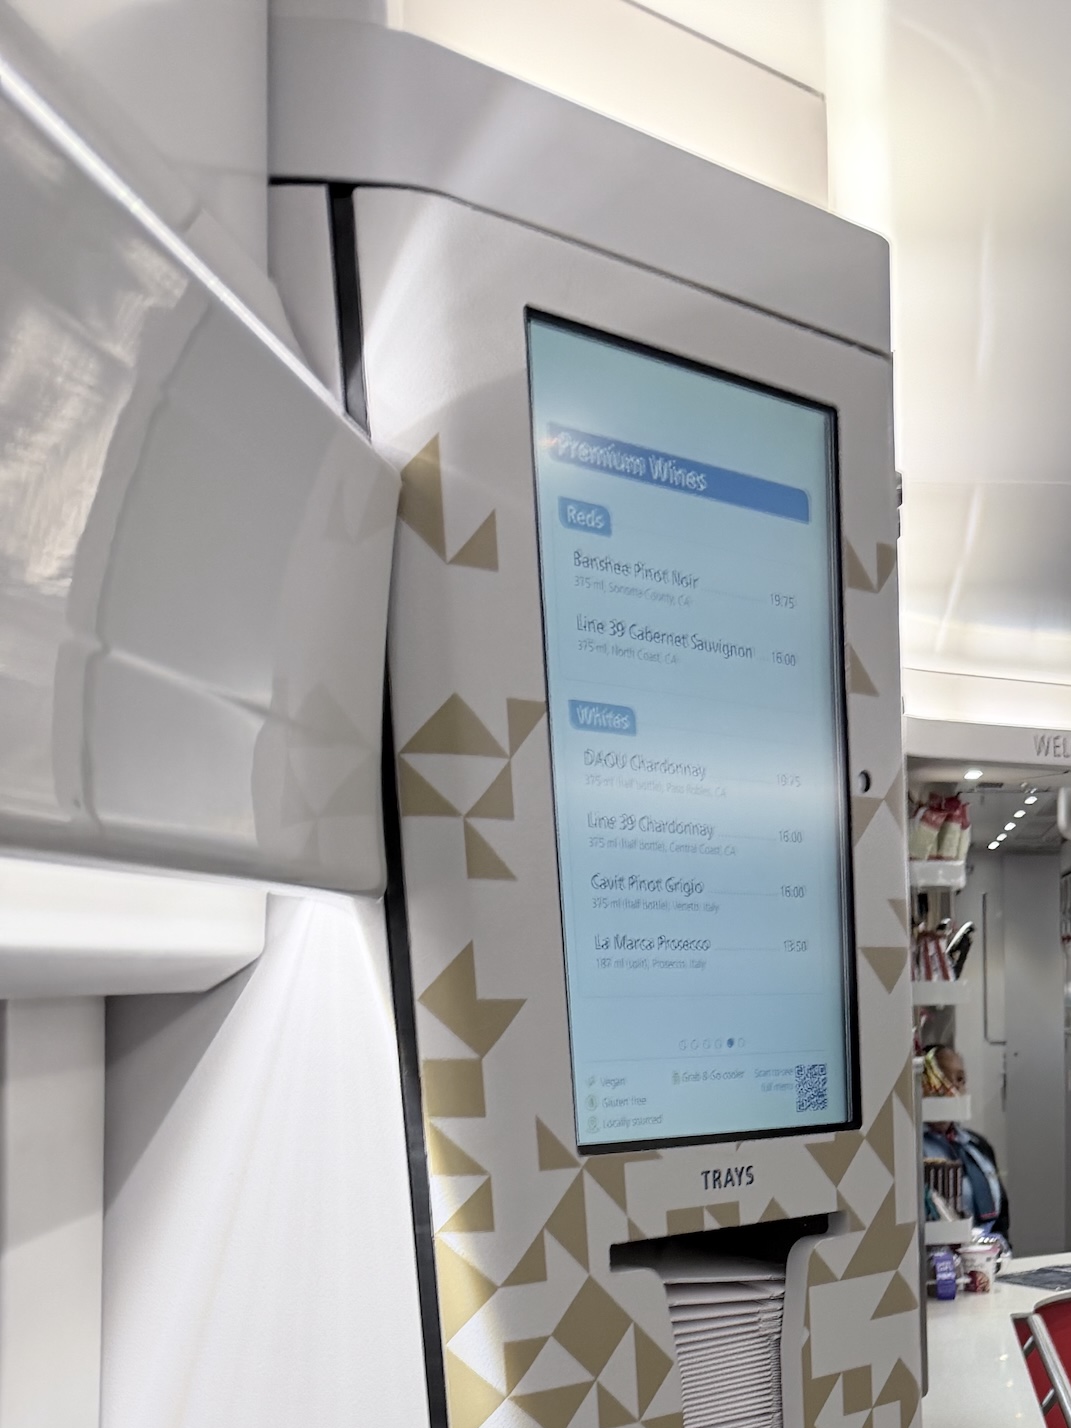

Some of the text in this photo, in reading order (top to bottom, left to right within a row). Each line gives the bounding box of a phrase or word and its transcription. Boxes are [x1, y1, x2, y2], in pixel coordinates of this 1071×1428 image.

[556, 431, 708, 491] Premium Wines
[566, 504, 605, 530] Reds
[573, 549, 699, 589] Banshee Pinot Noir
[770, 593, 795, 609] 19.75
[576, 614, 754, 660] Line 39 Cabernet Sauvignon
[576, 704, 630, 730] Whites
[584, 749, 706, 781] DAOU Chardonnay
[587, 812, 714, 840] Line 39 Chardonnay
[590, 873, 705, 898] Cavit Pinot Grigio
[594, 933, 711, 952] La Marca Prosecco
[701, 1165, 755, 1191] TRAYS
